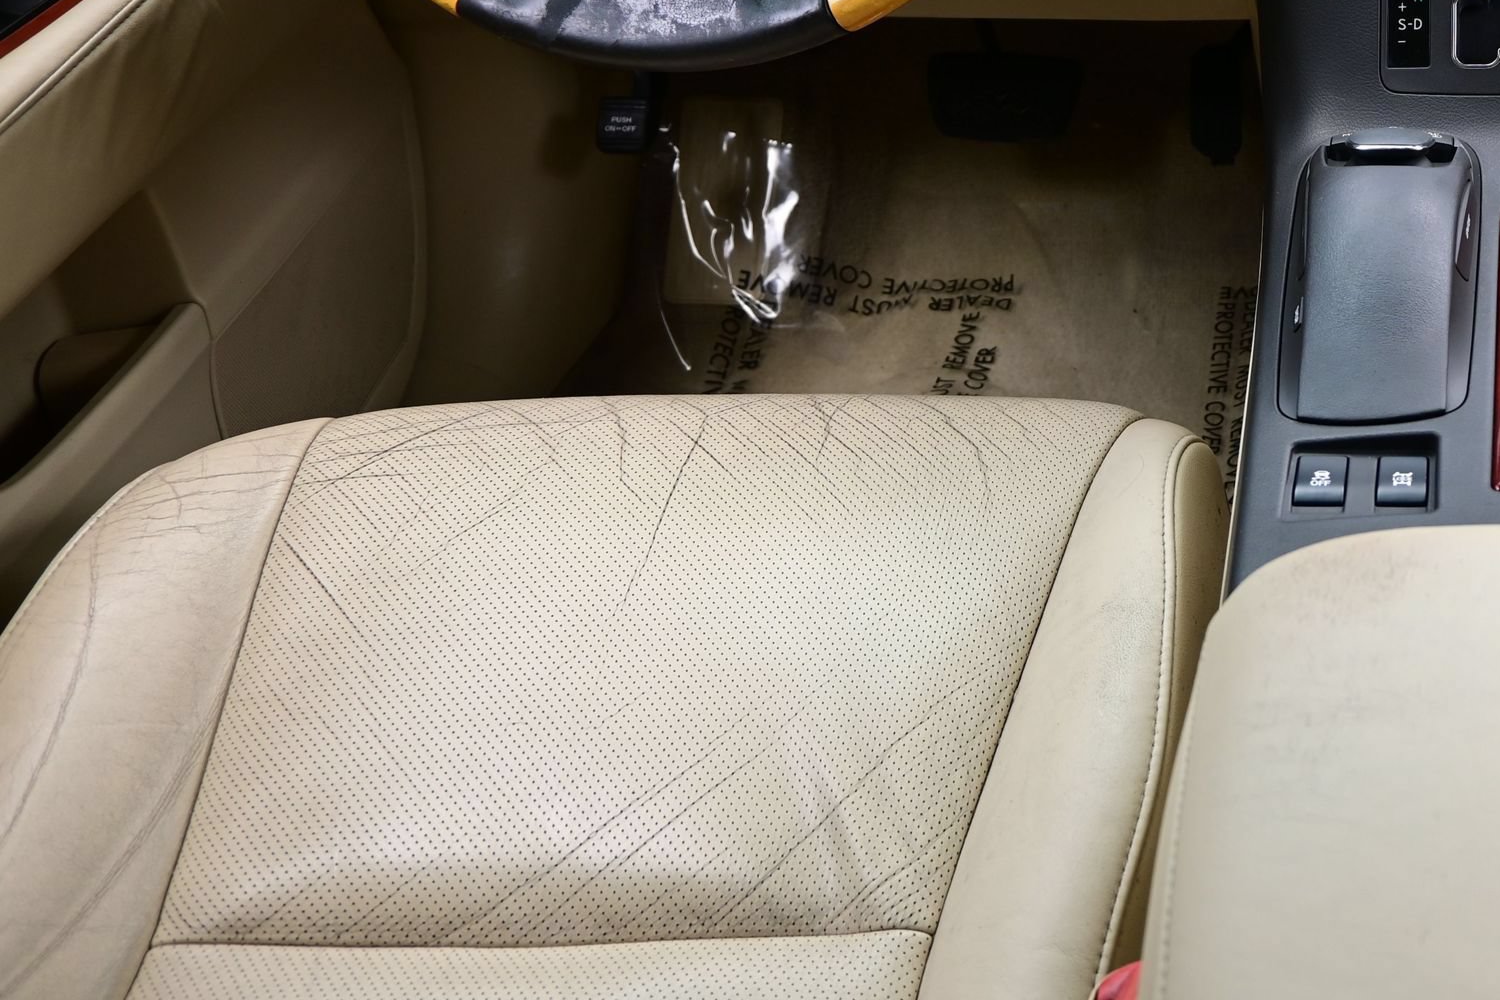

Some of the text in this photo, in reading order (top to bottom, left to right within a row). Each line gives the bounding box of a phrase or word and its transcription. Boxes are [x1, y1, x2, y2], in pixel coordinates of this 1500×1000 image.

[797, 255, 1015, 296] PROTECTIVE COVER
[928, 294, 1012, 312] DEALER
[941, 311, 980, 370] REMOVE
[1208, 302, 1236, 394] PROTECTIVE
[964, 346, 997, 390] COVER
